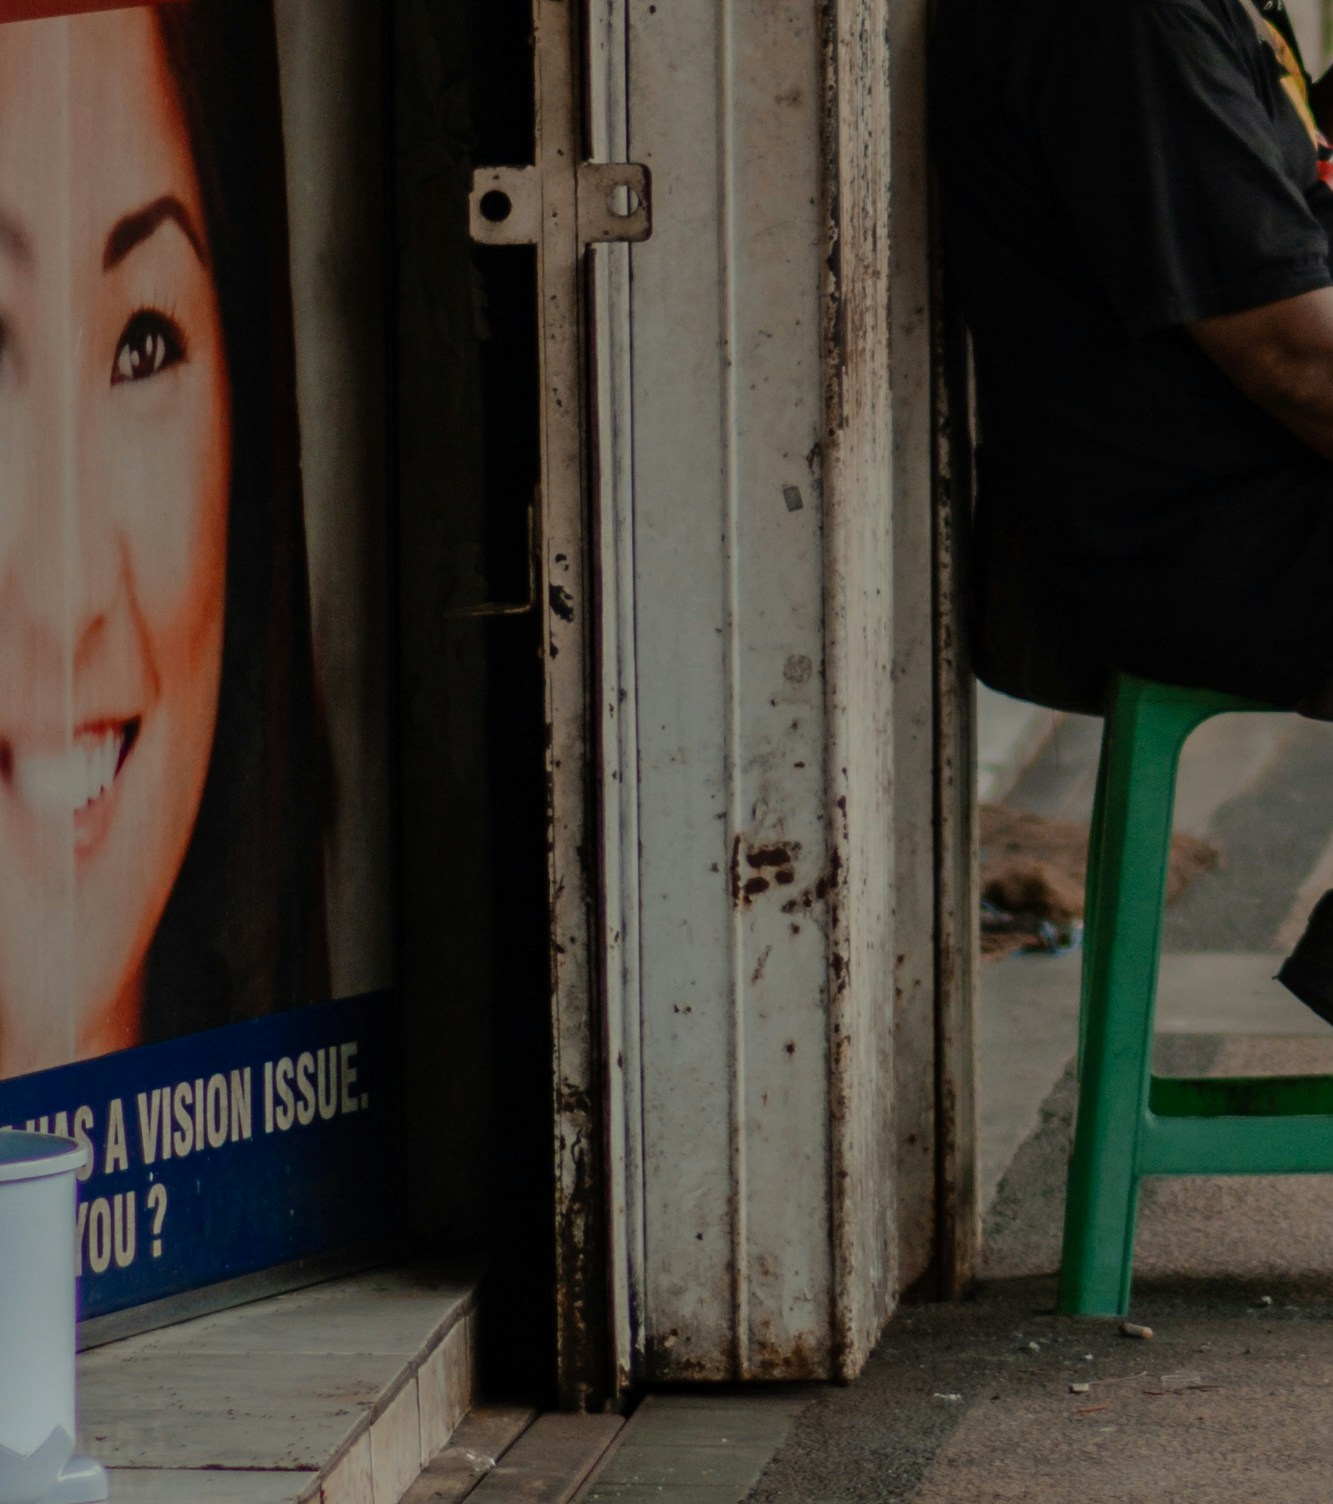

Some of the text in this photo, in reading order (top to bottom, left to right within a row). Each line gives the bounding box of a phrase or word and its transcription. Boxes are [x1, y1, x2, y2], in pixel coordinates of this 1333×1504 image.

[104, 1098, 128, 1174] A
[137, 1066, 252, 1165] VISION
[264, 1041, 369, 1134] ISSUE.
